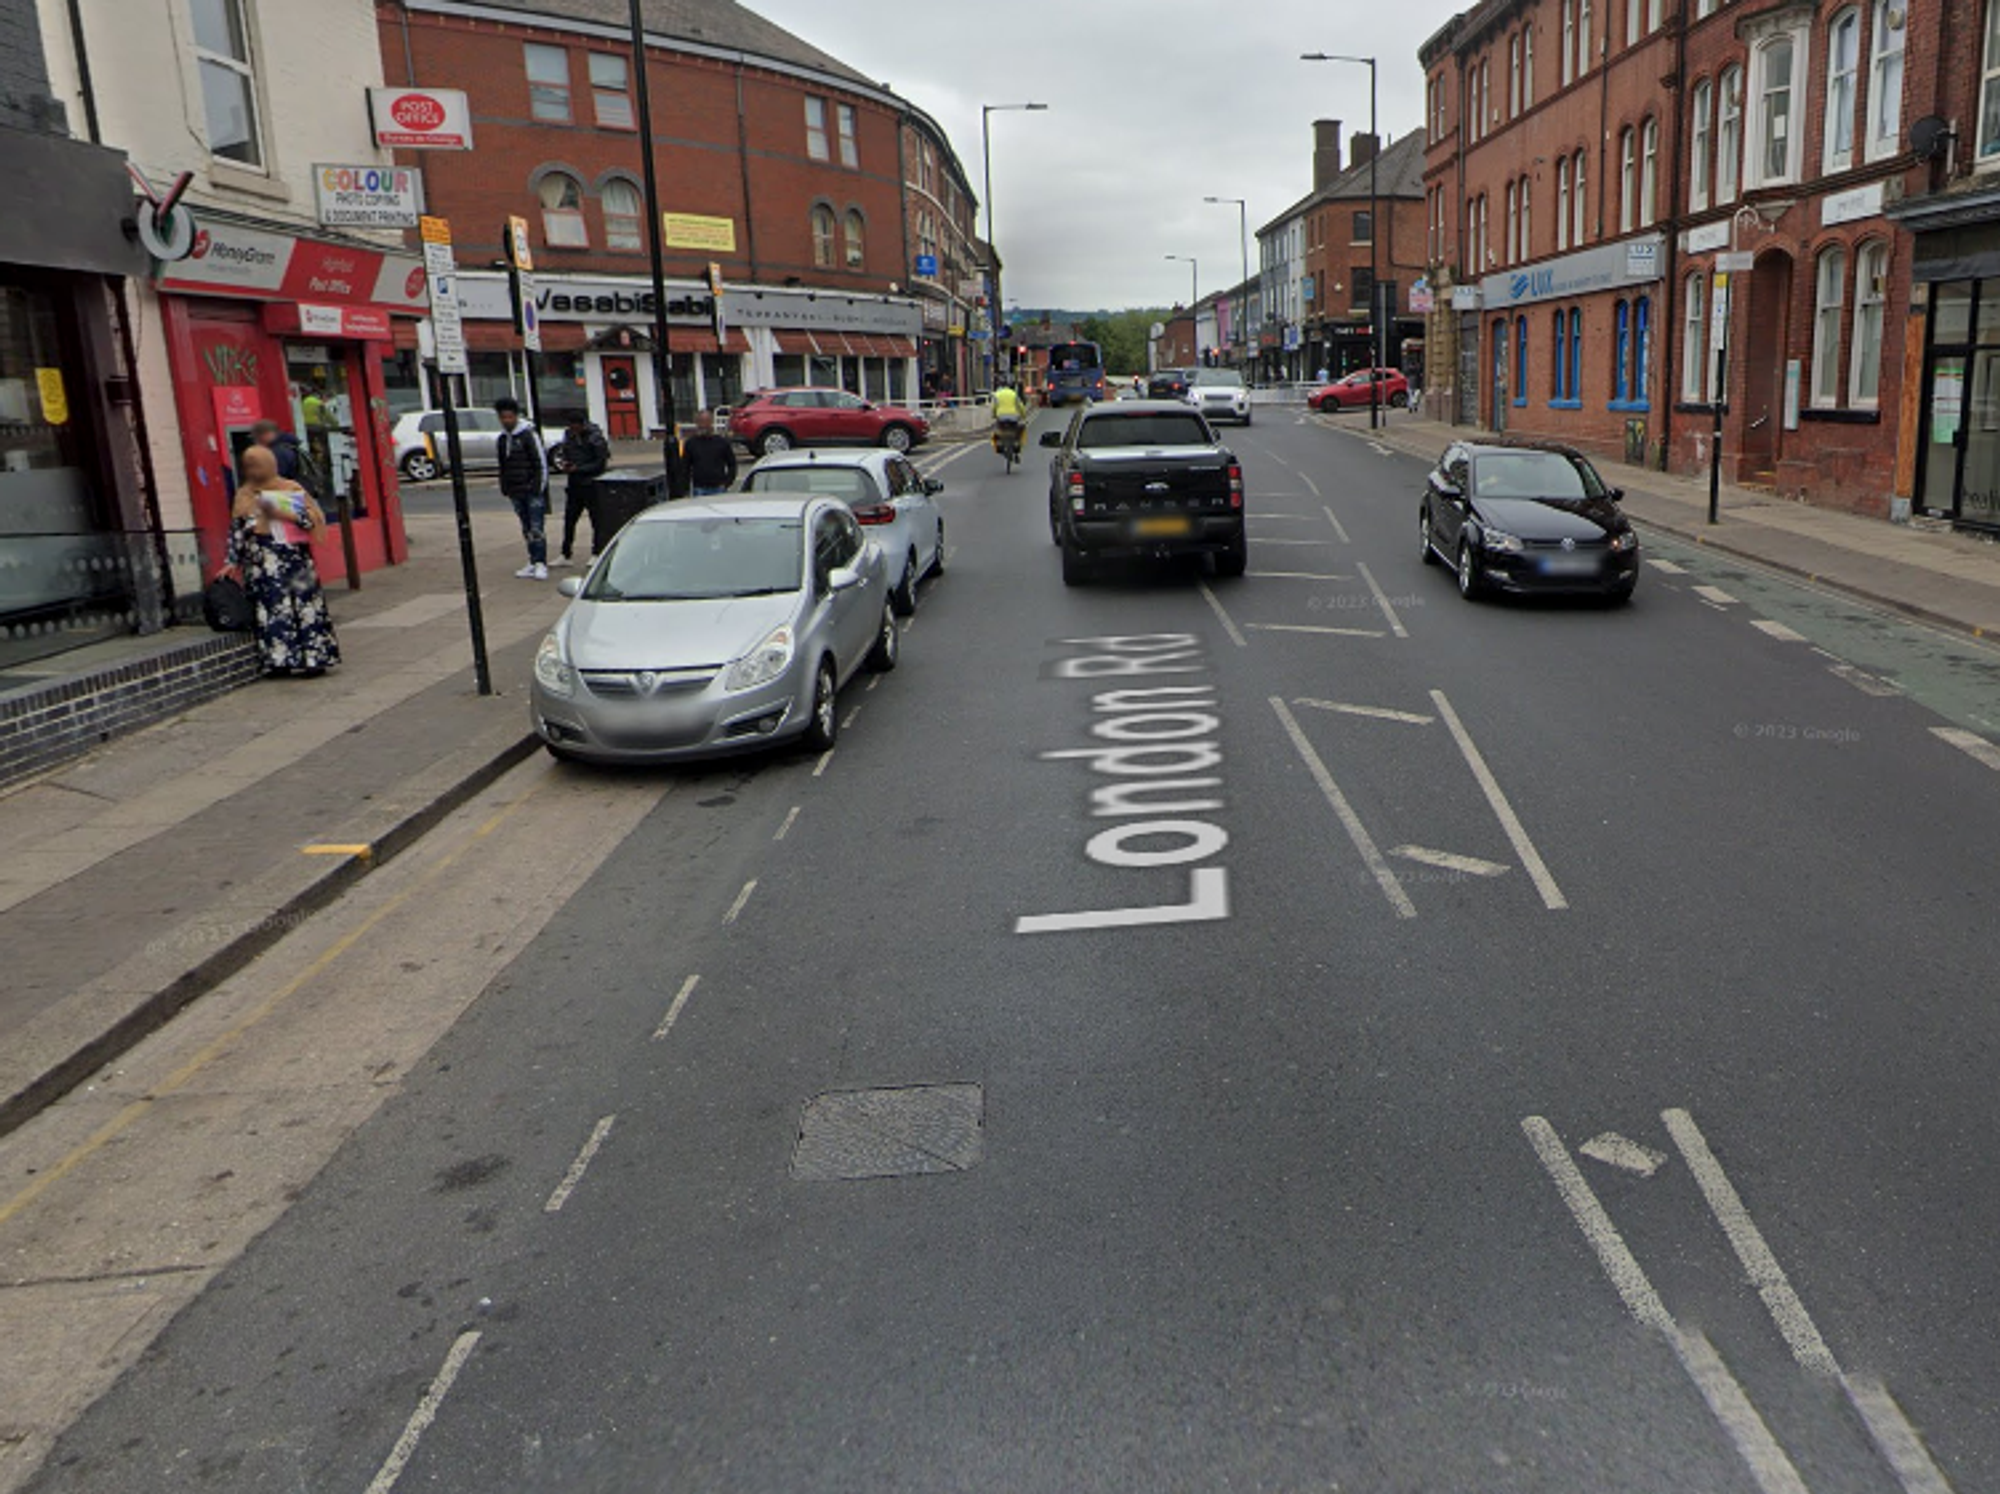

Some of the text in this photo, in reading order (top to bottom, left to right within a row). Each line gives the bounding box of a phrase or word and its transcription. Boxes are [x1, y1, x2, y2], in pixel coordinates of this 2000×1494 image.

[400, 101, 434, 113] POST
[396, 112, 440, 124] OFFICE
[322, 168, 409, 193] COLOUR
[210, 241, 276, 265] MoneyGram
